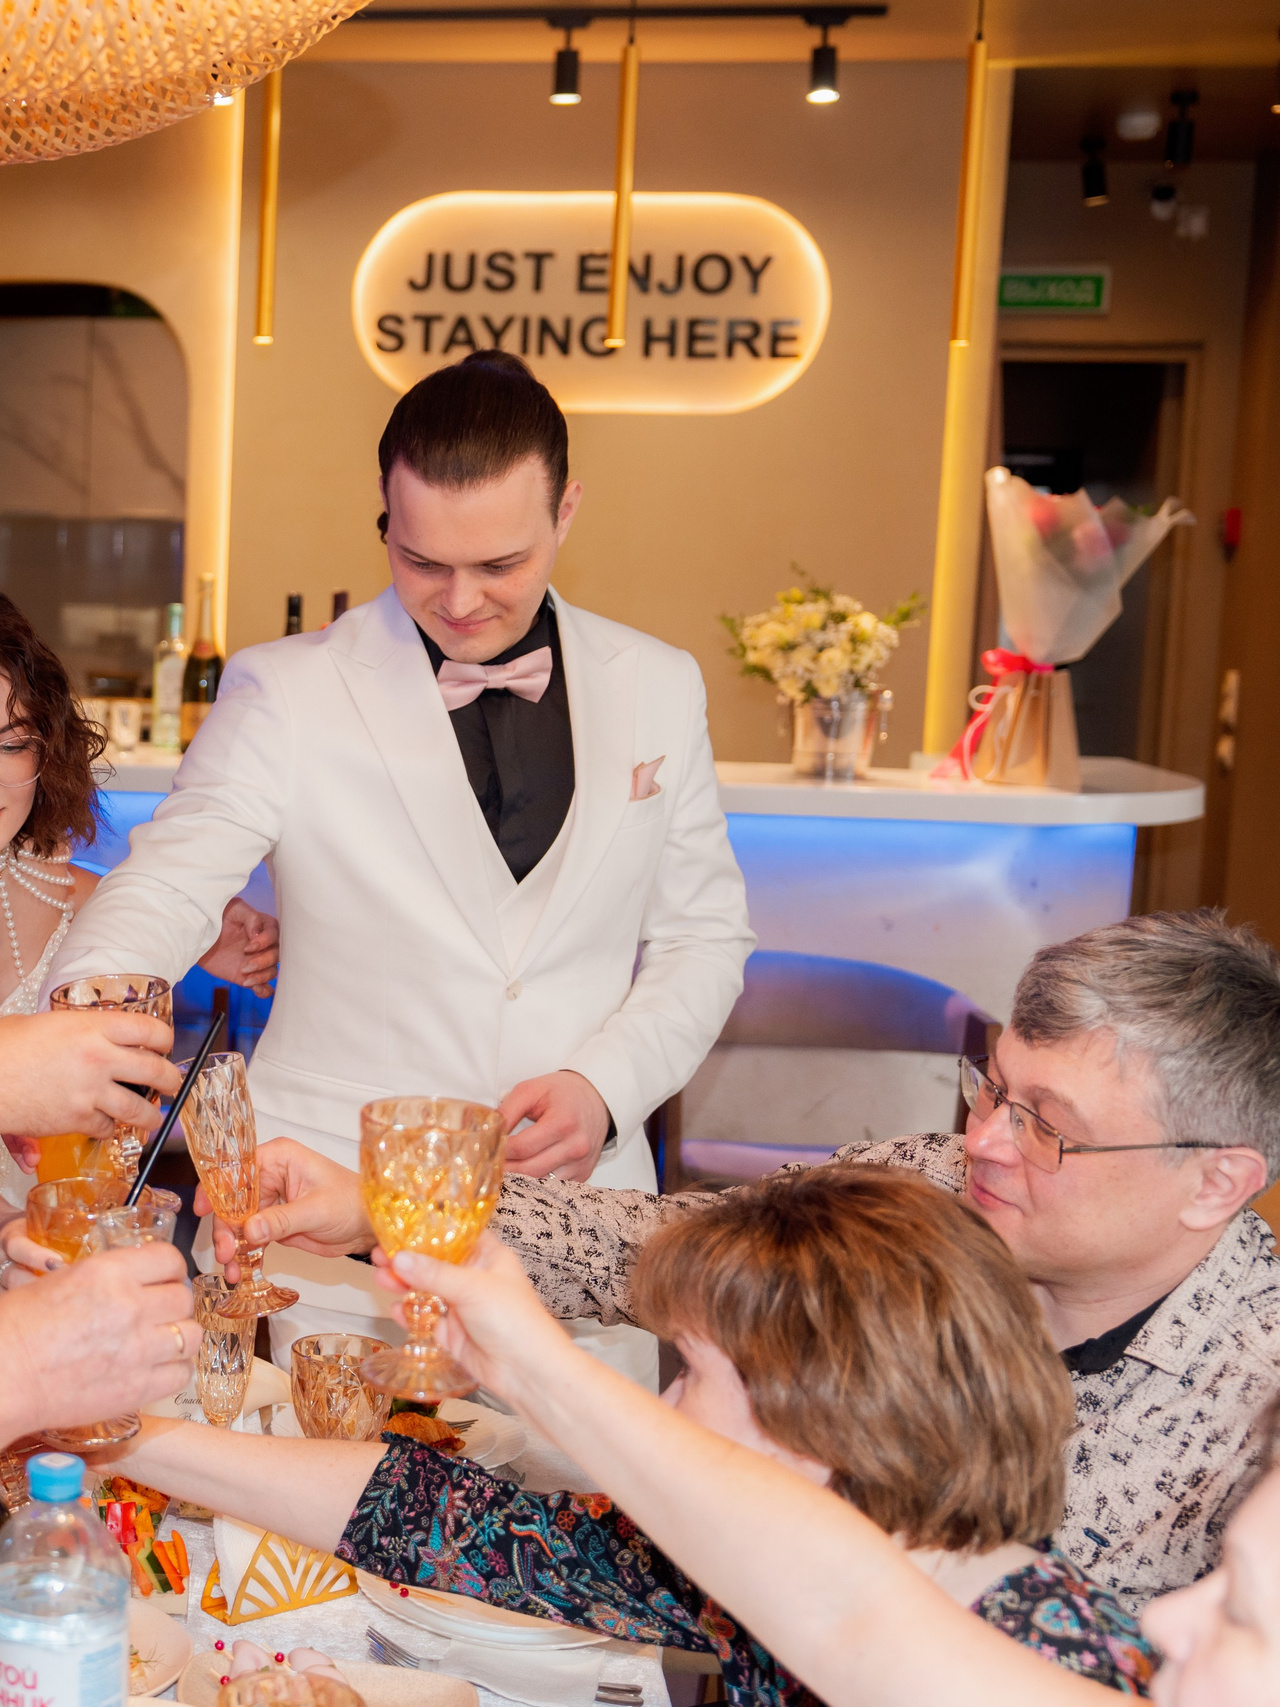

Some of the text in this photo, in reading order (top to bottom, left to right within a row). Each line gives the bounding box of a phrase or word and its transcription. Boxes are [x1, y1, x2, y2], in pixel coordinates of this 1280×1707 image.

[407, 251, 774, 296] JUST ENJOY
[375, 313, 802, 360] STAYING HERE
[172, 1391, 203, 1406] Спаси
